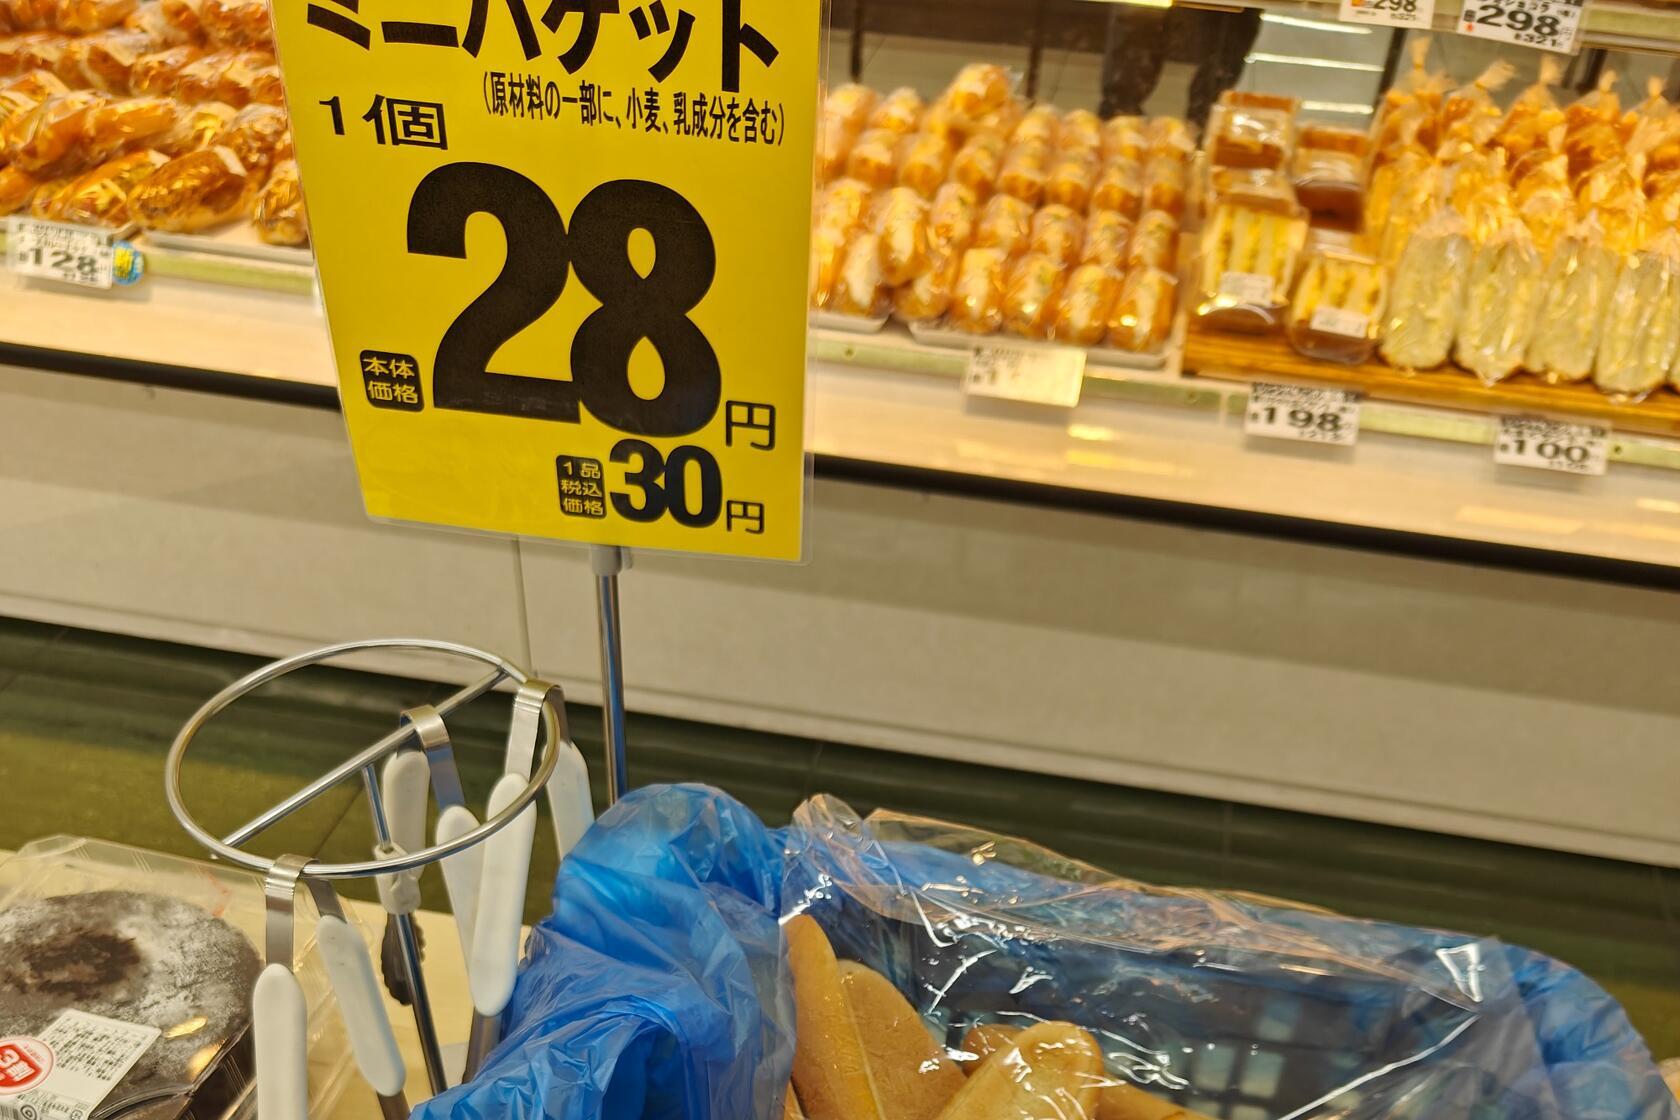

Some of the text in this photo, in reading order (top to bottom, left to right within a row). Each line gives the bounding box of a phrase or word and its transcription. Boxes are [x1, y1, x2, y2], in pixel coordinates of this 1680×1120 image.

[1477, 5, 1560, 36] 298
[30, 247, 98, 274] 128
[406, 161, 777, 452] 28 円
[362, 356, 415, 379] 本体
[368, 380, 418, 404] 価格
[1264, 406, 1341, 432] 198
[1515, 439, 1589, 463] 100
[561, 479, 602, 497] 税込
[609, 438, 765, 535] 30 円
[563, 498, 604, 515] 価格
